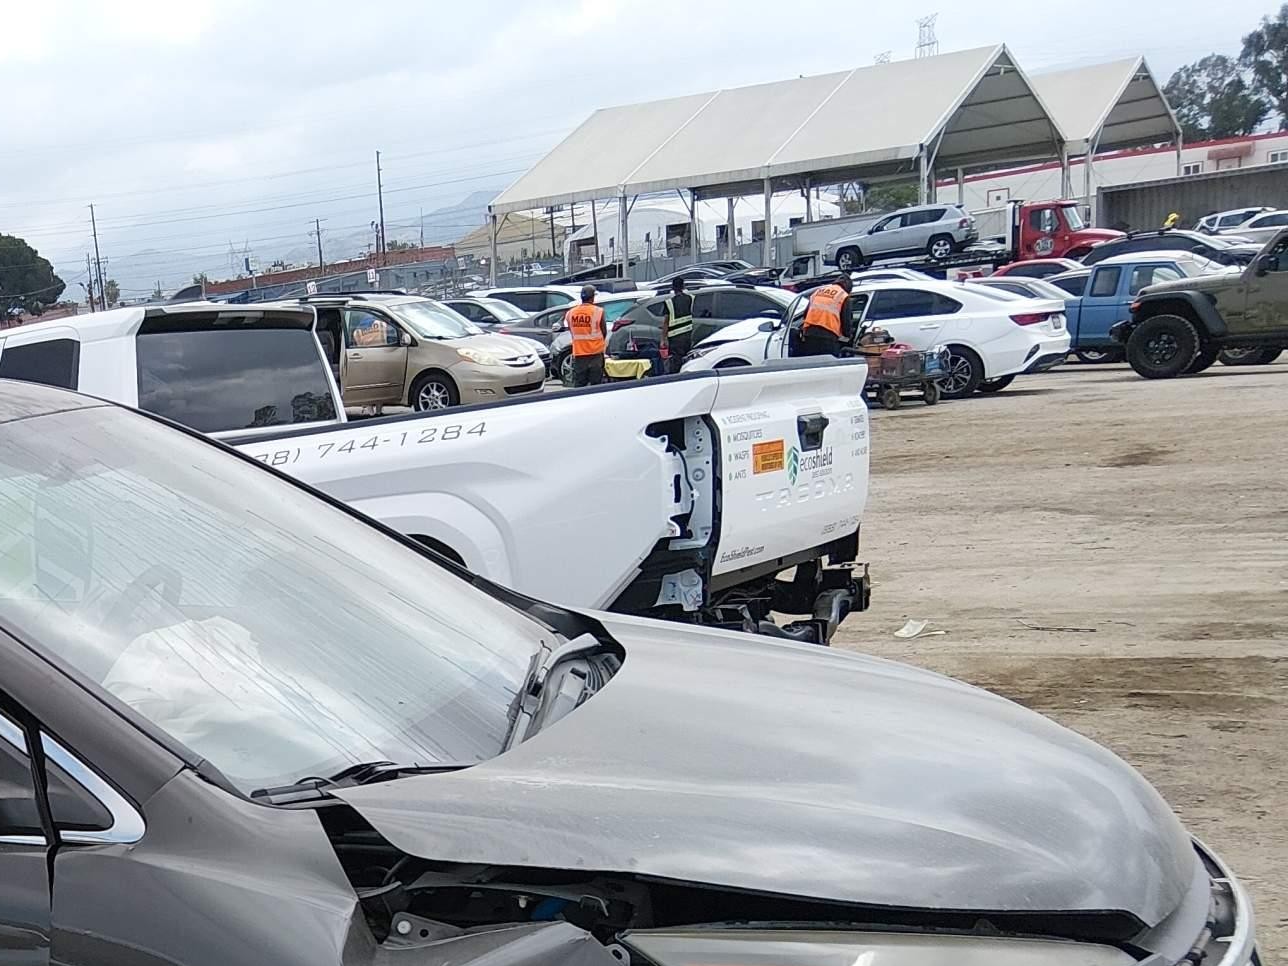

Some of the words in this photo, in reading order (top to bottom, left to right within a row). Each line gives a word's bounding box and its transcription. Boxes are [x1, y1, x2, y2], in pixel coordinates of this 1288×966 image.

[571, 315, 591, 324] MAD
[318, 421, 487, 459] 744-1284
[800, 446, 833, 472] ecoshield
